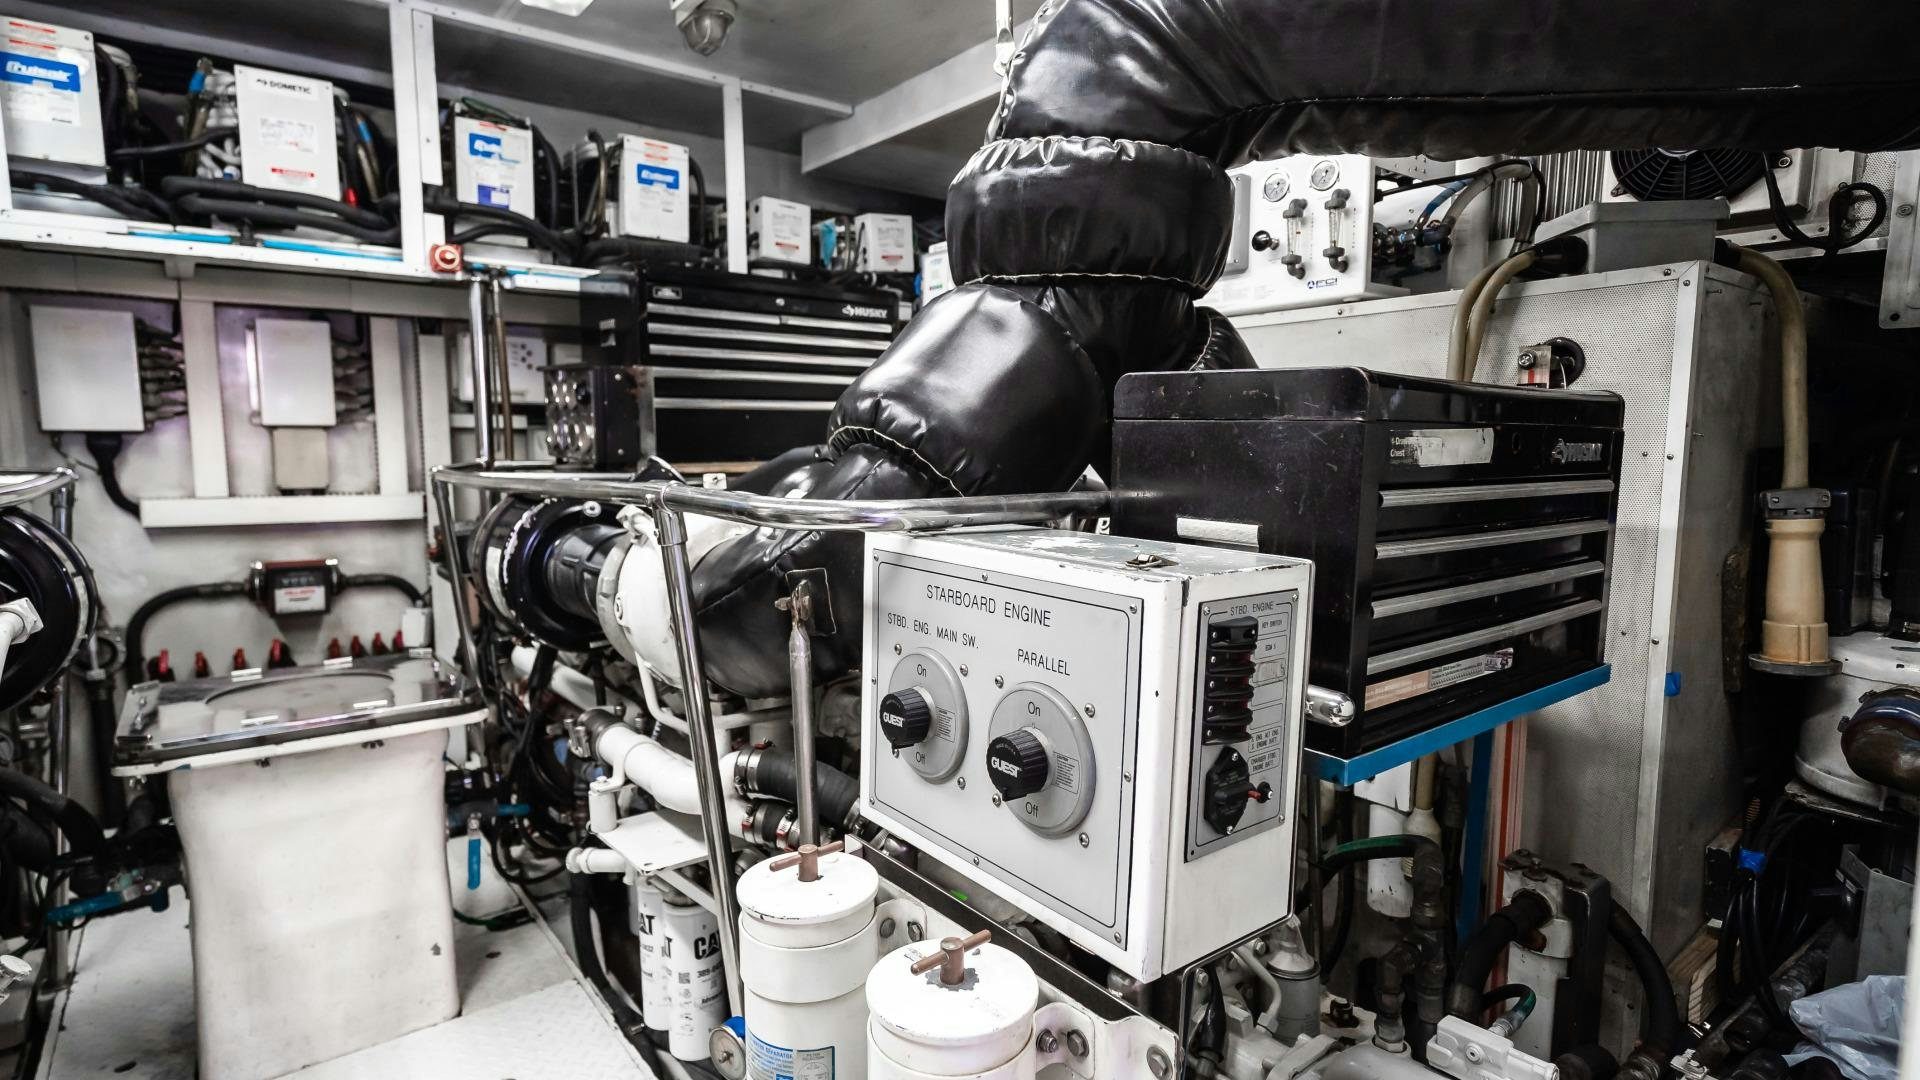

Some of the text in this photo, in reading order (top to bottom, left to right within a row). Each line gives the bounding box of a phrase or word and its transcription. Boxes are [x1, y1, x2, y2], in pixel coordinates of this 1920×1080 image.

[269, 80, 313, 95] DOMETIC
[854, 306, 888, 319] HUSKY
[1390, 448, 1406, 458] Chest
[926, 584, 1052, 627] STARBOARD ENGINE
[1230, 601, 1274, 617] STBD. ENGINE
[887, 612, 979, 649] STBD. ENG. MAIN SW.
[916, 663, 927, 677] On
[1017, 648, 1070, 676] PARALLEL
[1027, 701, 1041, 717] On
[883, 711, 904, 728] GUEST
[915, 751, 926, 765] Off
[991, 756, 1018, 778] GUEST
[1025, 801, 1039, 818] Off
